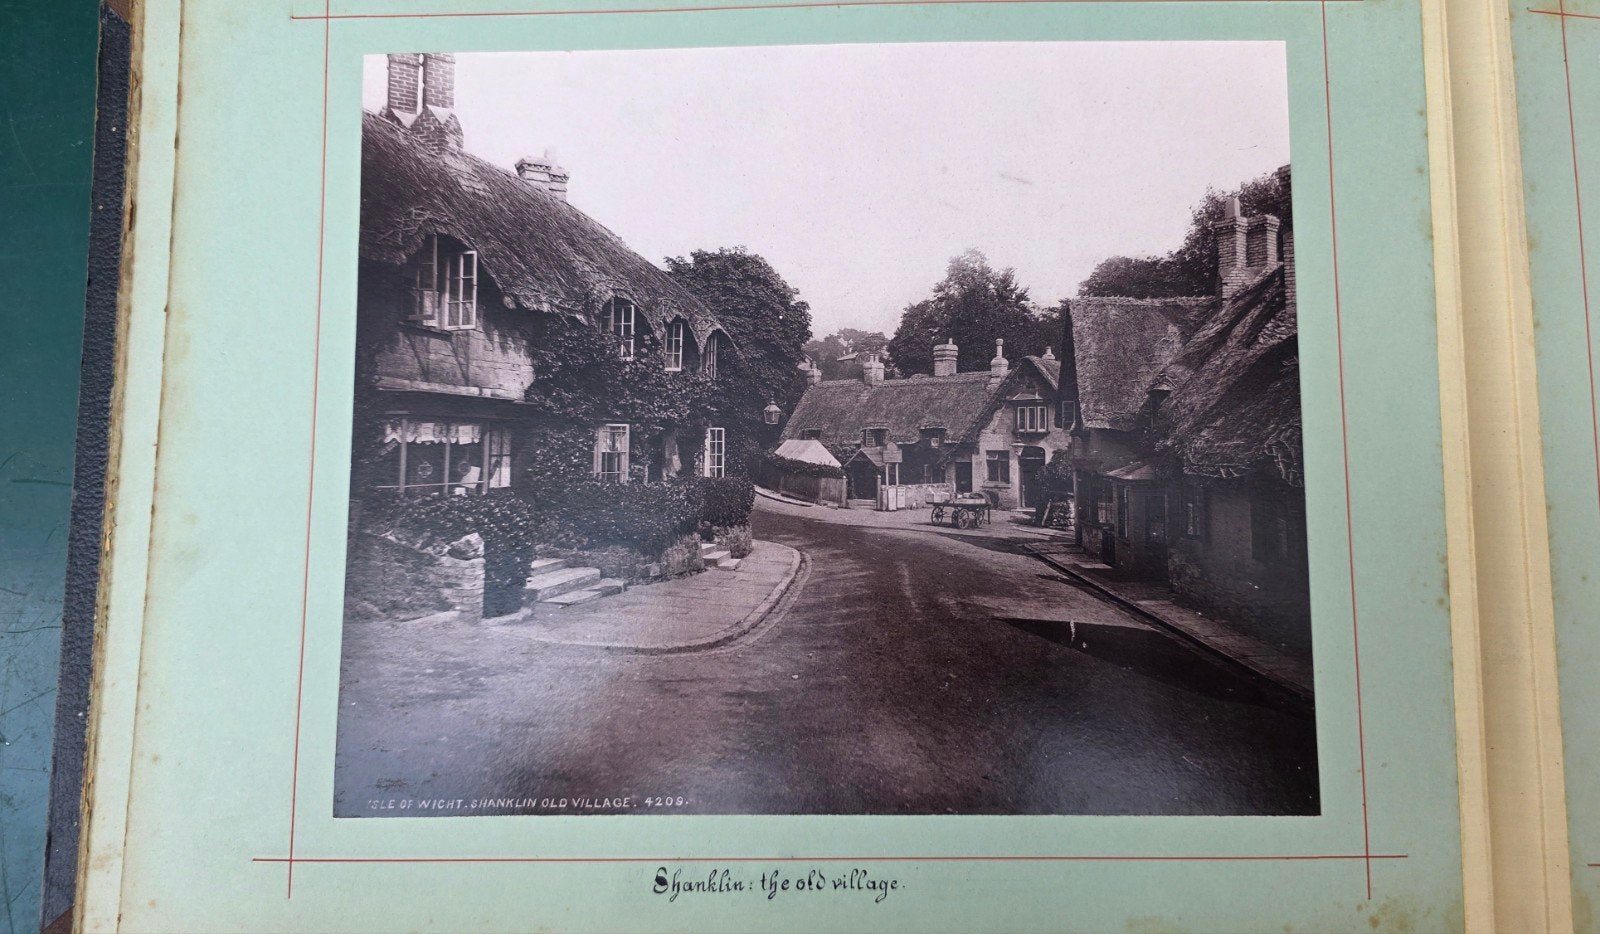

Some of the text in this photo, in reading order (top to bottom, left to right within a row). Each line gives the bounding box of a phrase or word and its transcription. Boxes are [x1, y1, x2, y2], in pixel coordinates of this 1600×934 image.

[400, 799, 413, 809] OF
[470, 798, 537, 808] SHANKLIN
[541, 798, 568, 808] OLD
[572, 797, 637, 808] VILLAGE.
[760, 869, 790, 900] the
[796, 869, 826, 891] old
[832, 869, 906, 903] village.
